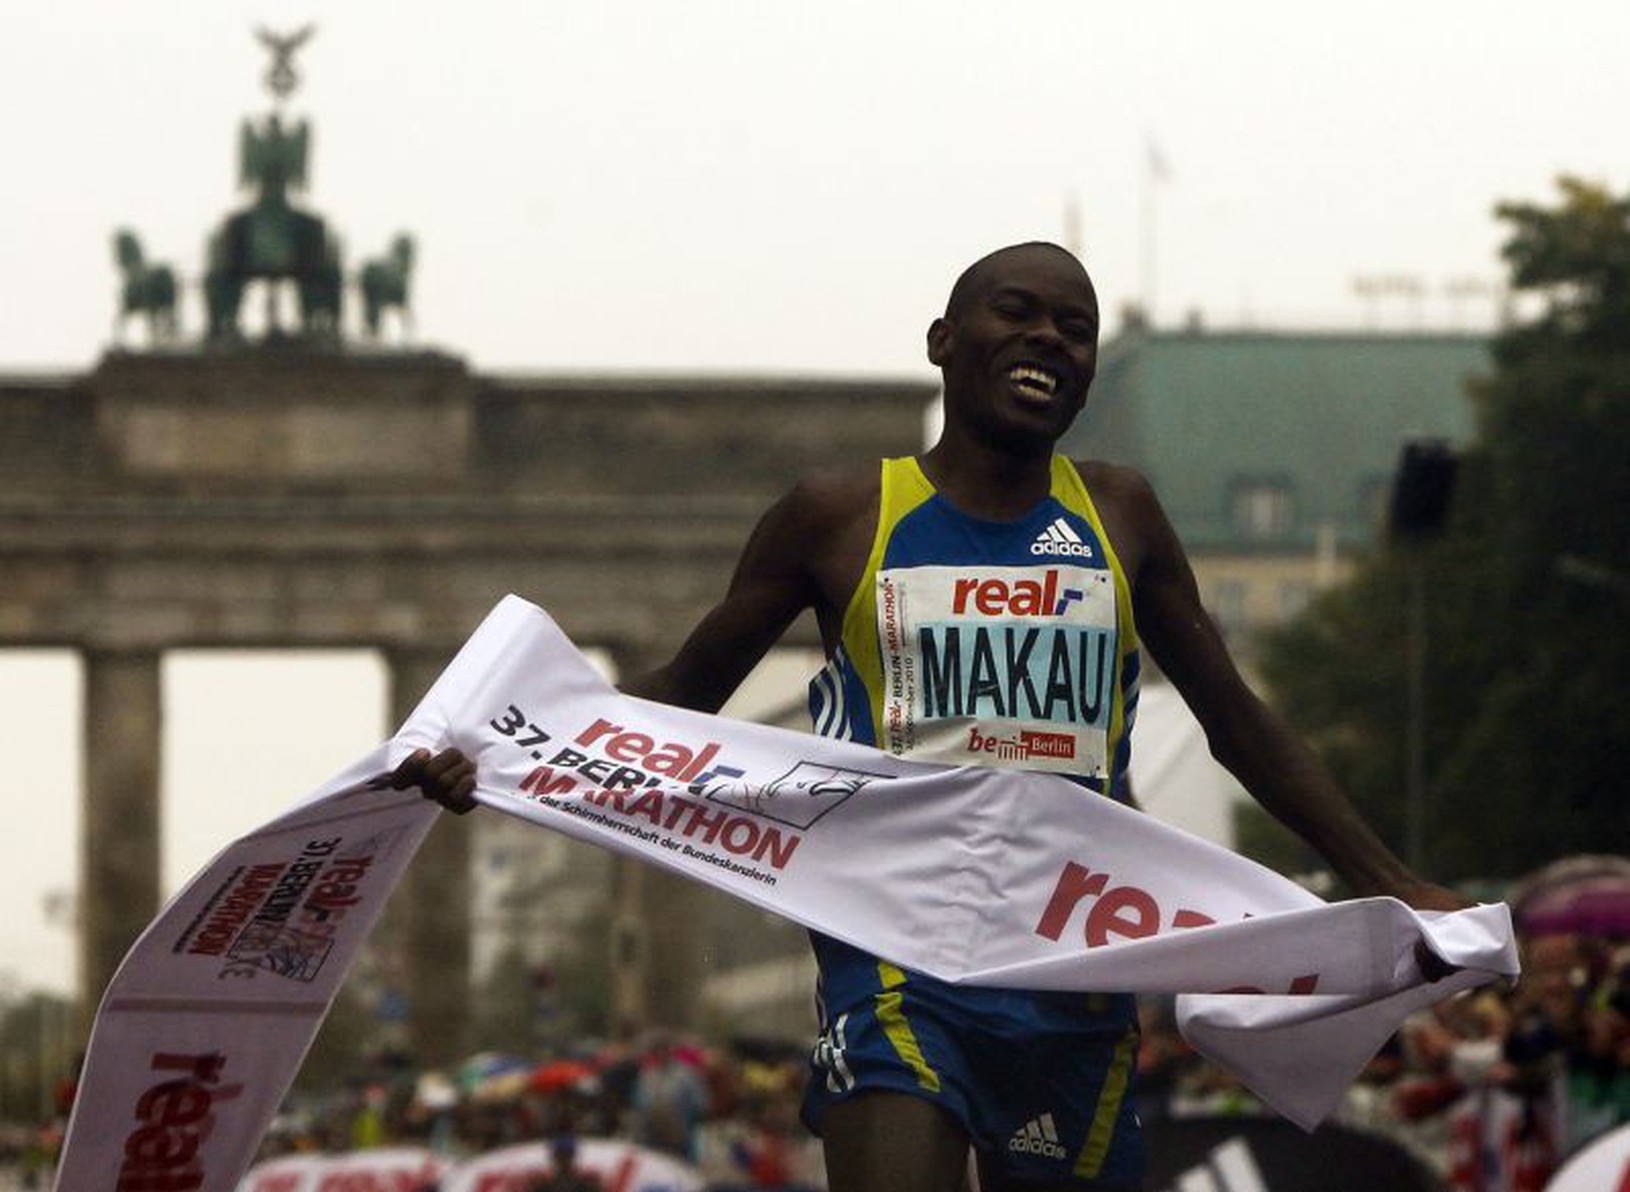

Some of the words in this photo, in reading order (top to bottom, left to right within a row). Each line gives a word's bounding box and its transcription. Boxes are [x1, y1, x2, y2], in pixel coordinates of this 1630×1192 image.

[1030, 539, 1093, 558] adidas
[919, 626, 1107, 725] MAKAU
[1032, 737, 1071, 755] Berlin
[540, 795, 560, 809] der
[562, 801, 660, 844] Schirmherrschaft
[661, 835, 681, 851] der
[683, 843, 777, 887] Bundeskanzlerin
[1007, 1136, 1067, 1161] adidas
